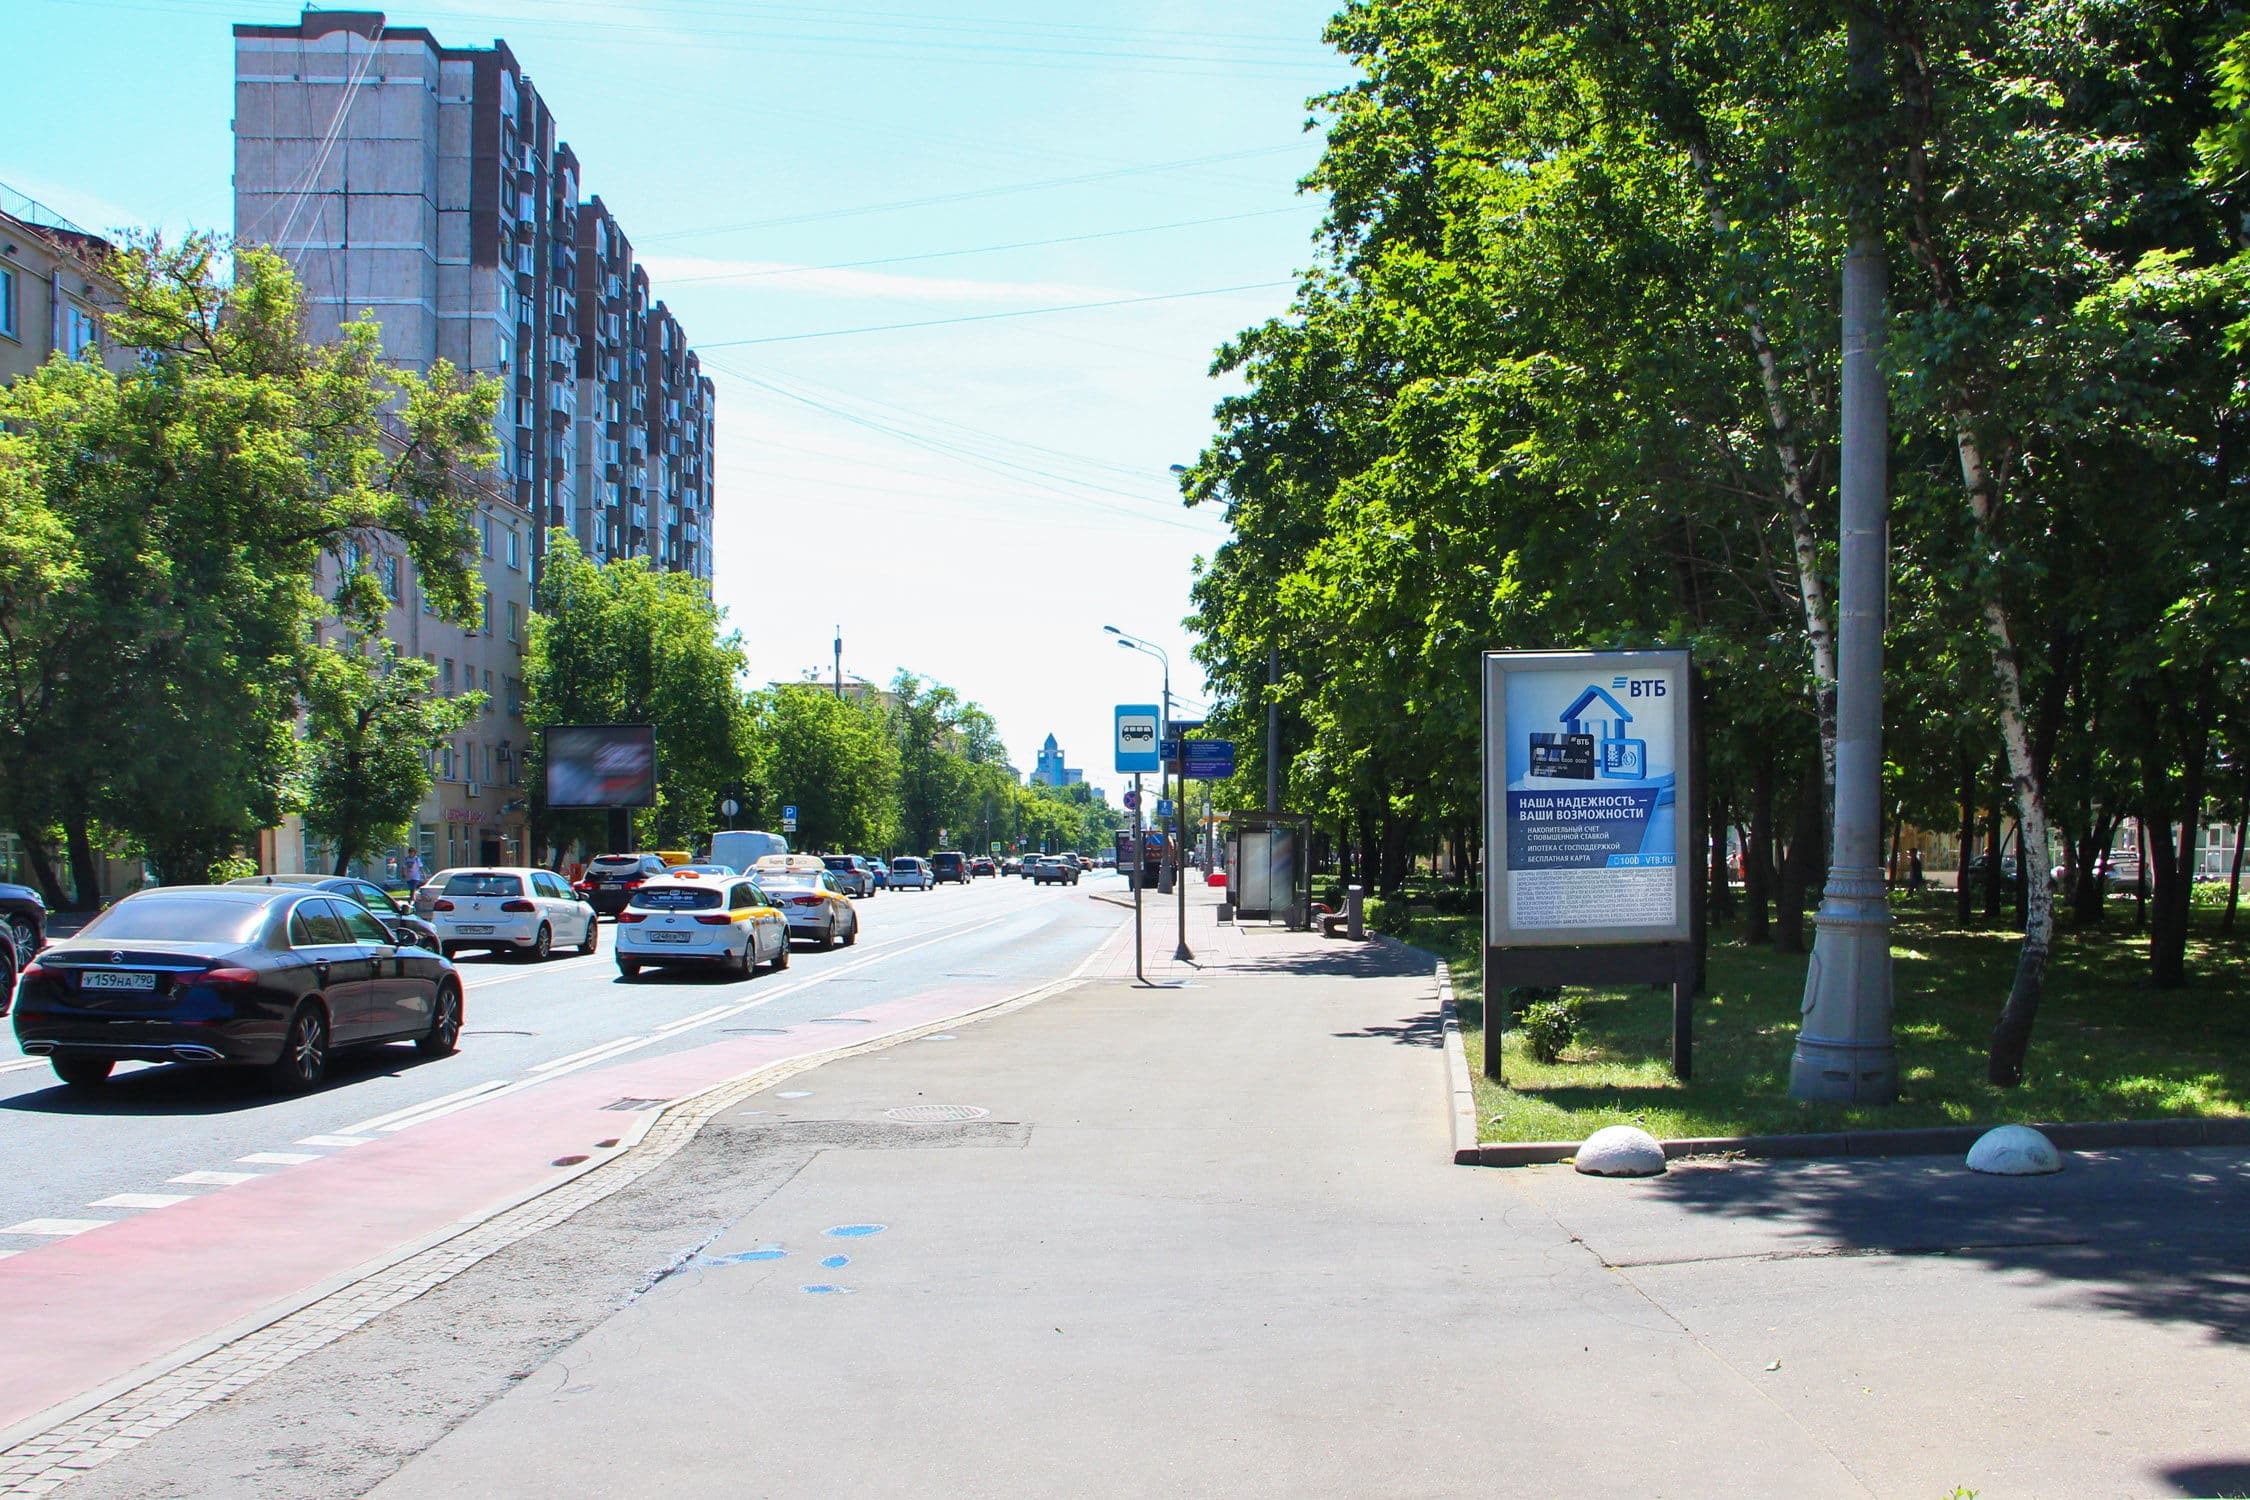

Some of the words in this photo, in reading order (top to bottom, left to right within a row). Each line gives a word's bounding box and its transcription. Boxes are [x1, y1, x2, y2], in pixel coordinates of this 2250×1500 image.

[1630, 680, 1667, 698] ВТБ
[1576, 738, 1590, 746] ВТБ
[1519, 798, 1554, 809] НАША
[1556, 796, 1636, 809] НАДЕЖНОСТЬ
[786, 807, 794, 818] P
[1519, 810, 1553, 821] ВАШИ
[1556, 808, 1644, 820] ВОЗМОЖНОСТИ
[1527, 825, 1583, 834] НАКОПИТЕЛЬНЫЙ
[1584, 825, 1600, 833] СЧЕТ
[1533, 832, 1579, 841] ПОВЫШЕННОЙ
[1580, 831, 1610, 840] СТАВКОЙ
[1527, 844, 1558, 852] ИПОТЕКА
[1564, 842, 1621, 851] ГОСПОДДЕРЖКОЙ
[1527, 855, 1569, 863] БЕСПЛАТНАЯ
[1645, 856, 1673, 864] VTB.RU
